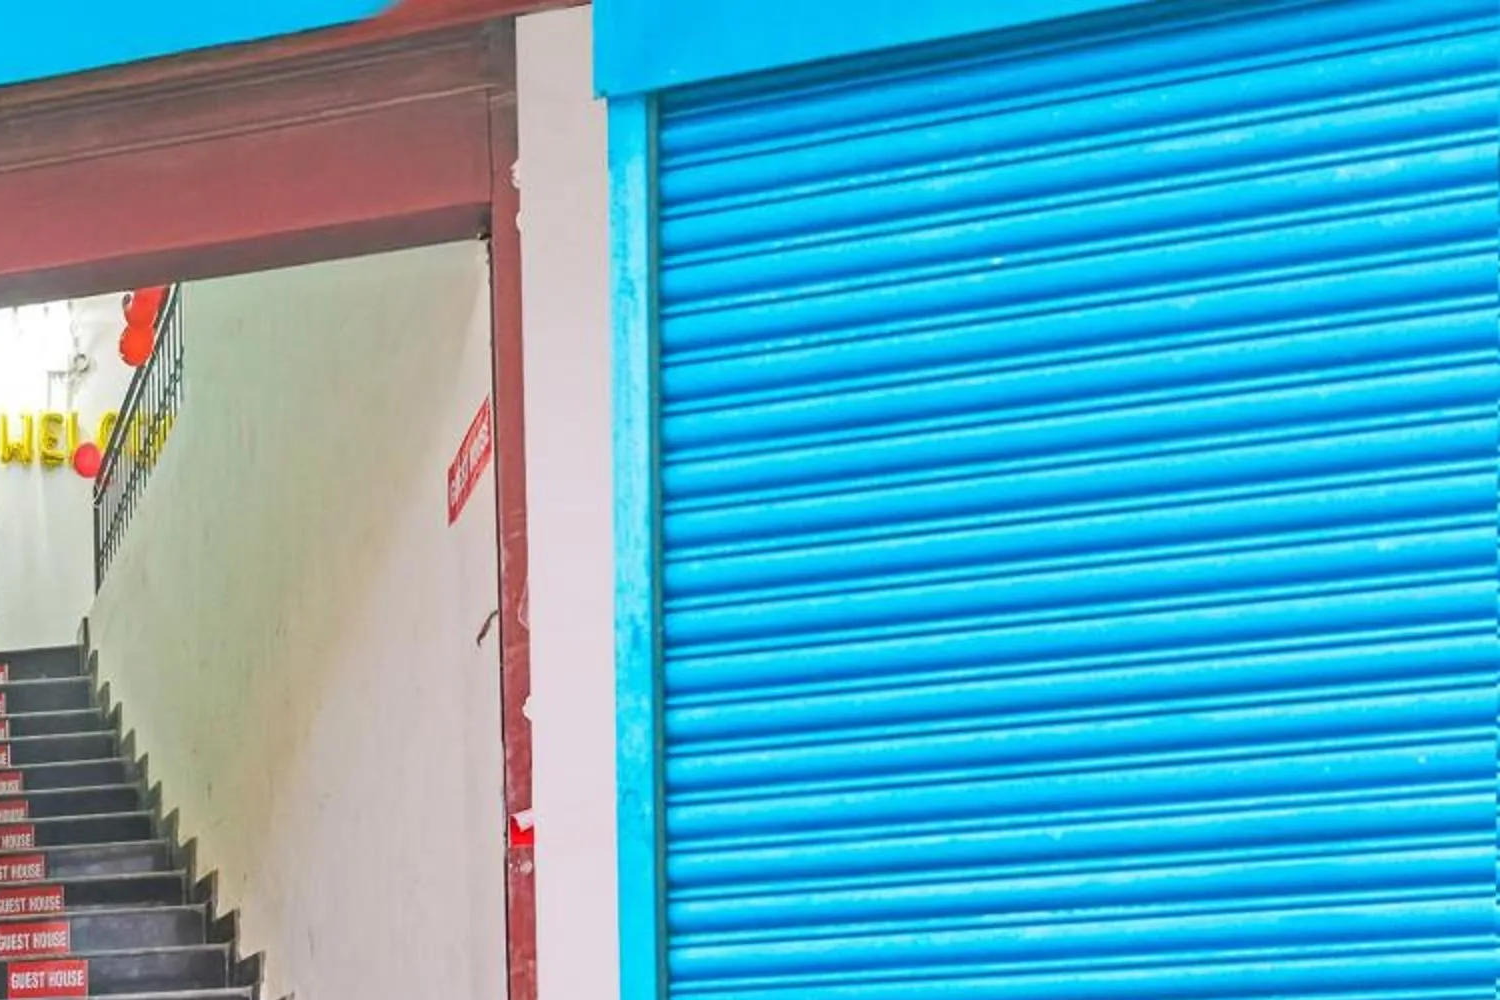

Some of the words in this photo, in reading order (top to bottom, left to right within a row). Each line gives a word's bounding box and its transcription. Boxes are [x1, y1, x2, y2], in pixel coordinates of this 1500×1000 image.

[32, 931, 67, 948] HOUSE
[11, 971, 45, 989] GUEST
[49, 969, 85, 987] HOUSE
